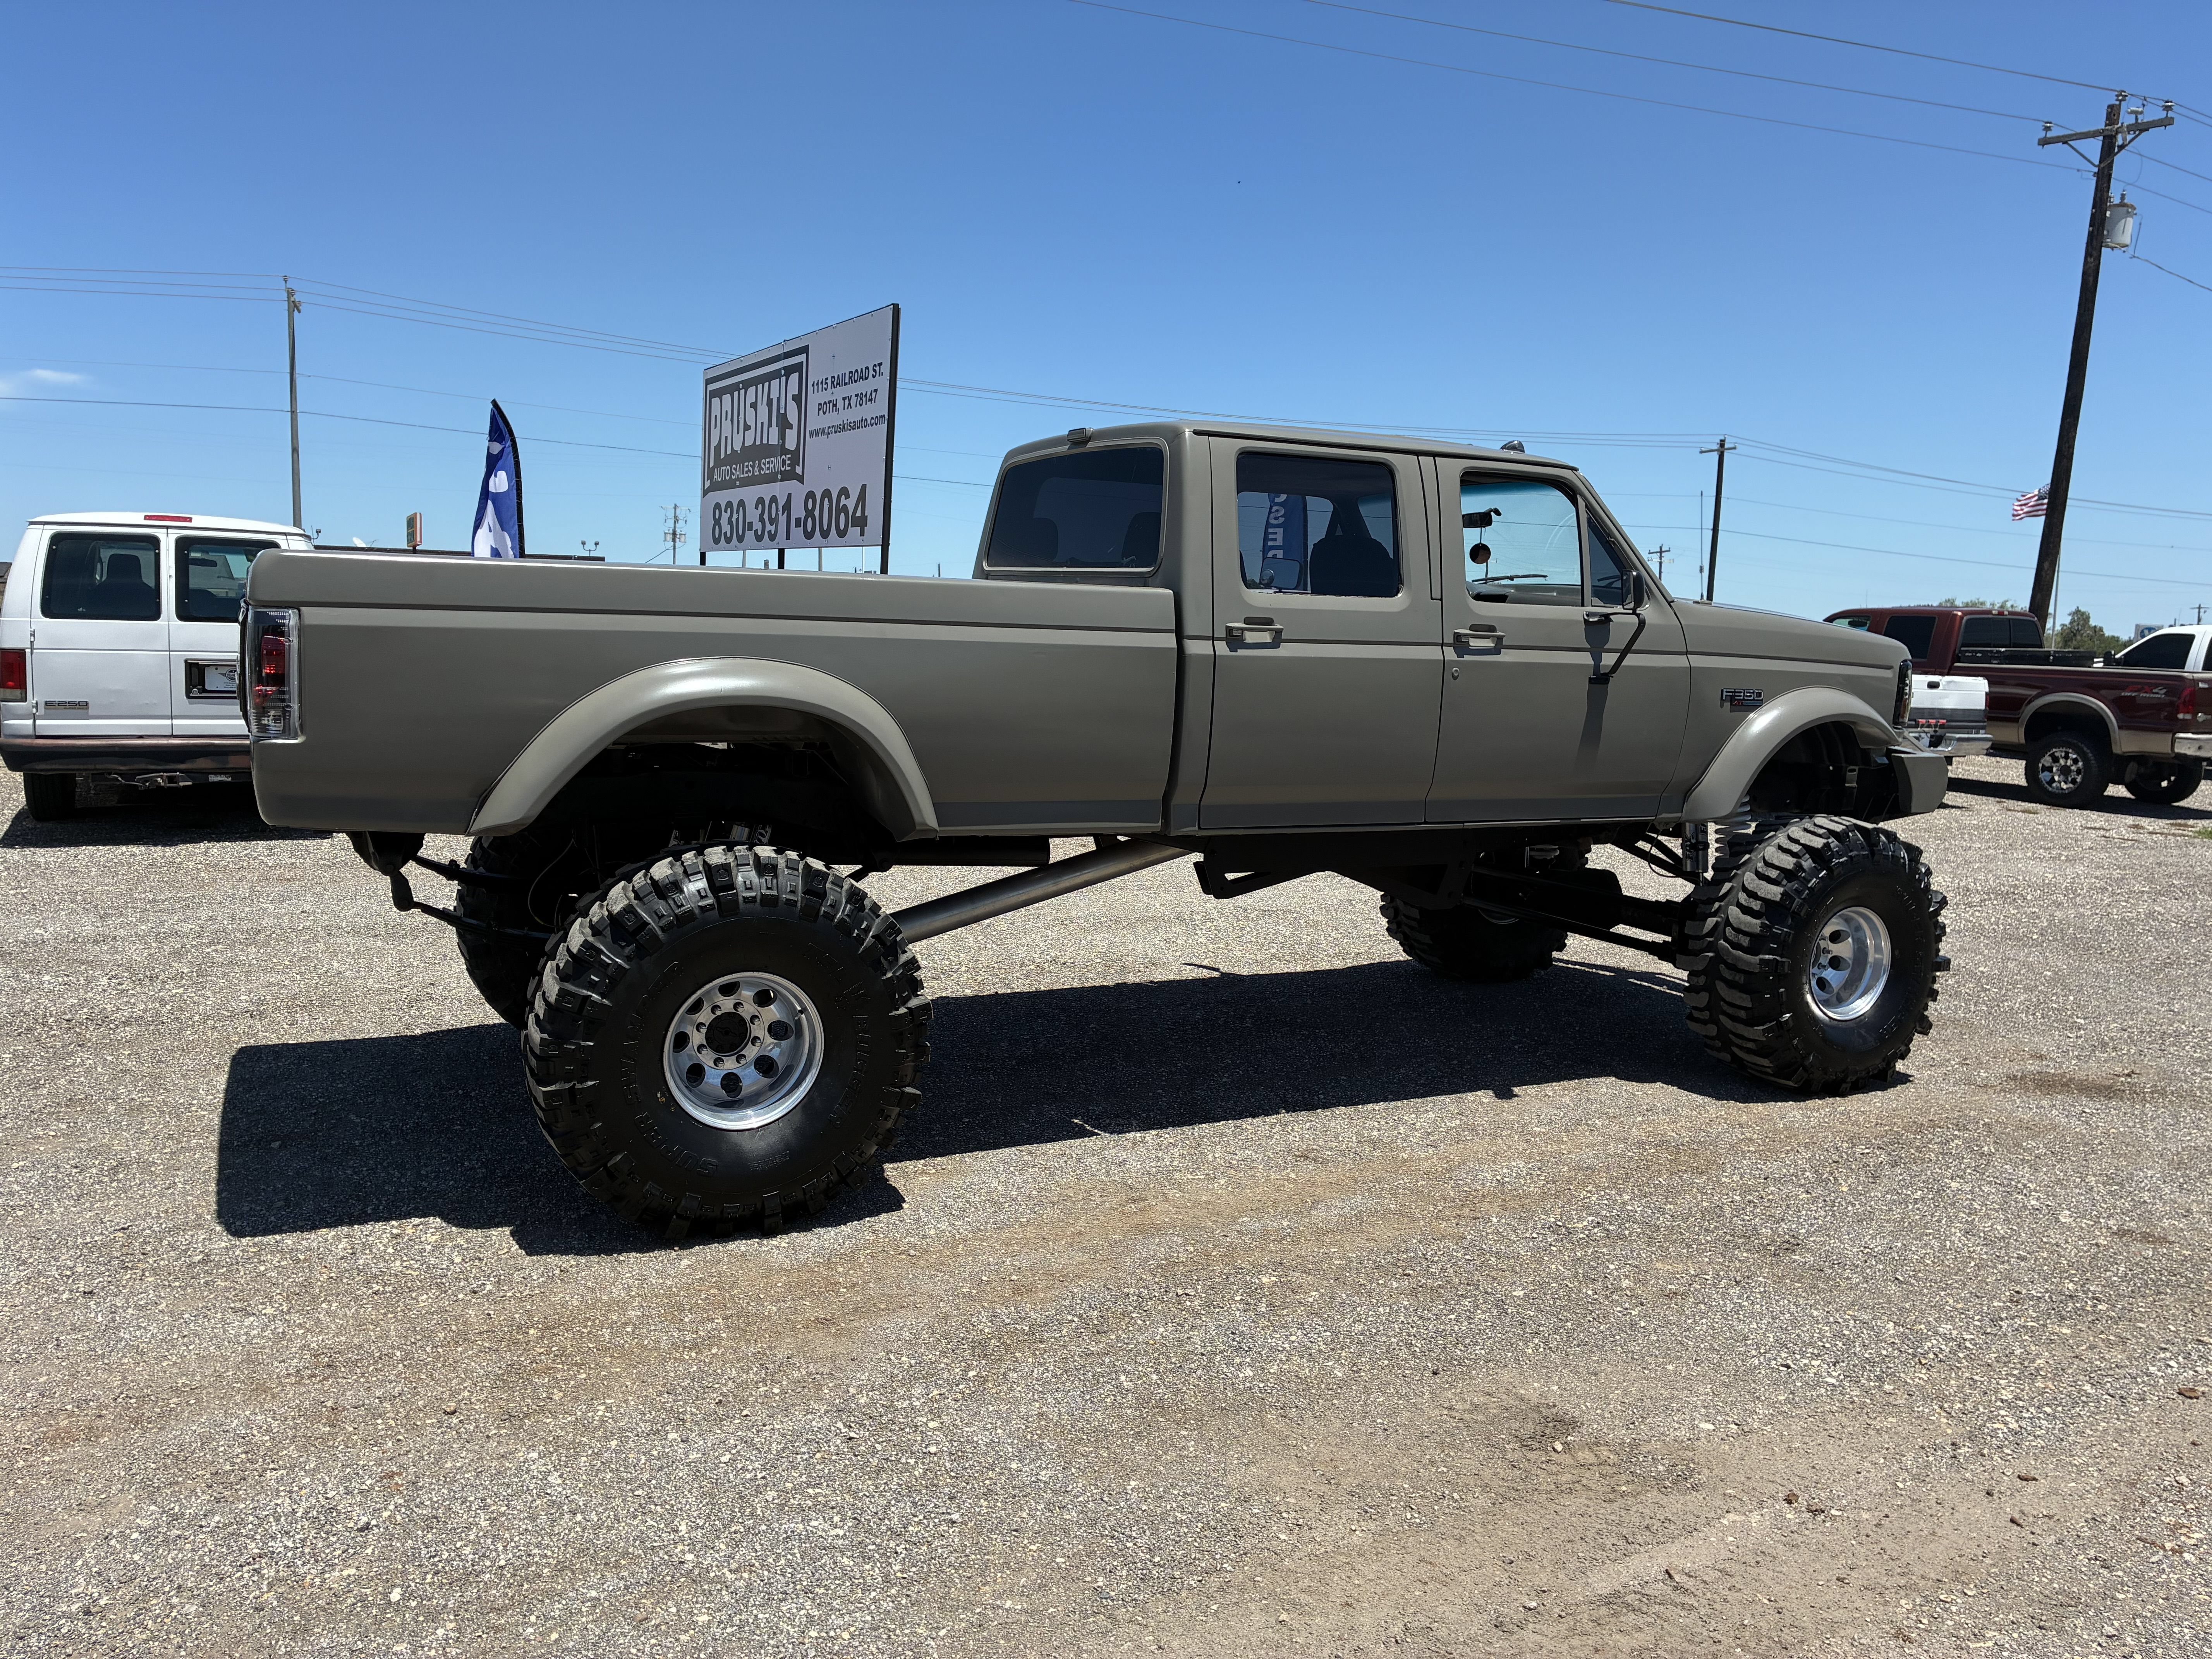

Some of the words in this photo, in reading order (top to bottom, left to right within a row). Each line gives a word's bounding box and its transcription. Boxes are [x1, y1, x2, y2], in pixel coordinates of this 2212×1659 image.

[812, 377, 828, 394] 1115
[830, 366, 870, 390] RAILROAD
[872, 362, 883, 379] ST.
[817, 398, 840, 416] POTH,
[842, 395, 852, 410] TX
[854, 388, 878, 408] 78147
[710, 372, 799, 468] PRUSKI'S
[809, 414, 885, 439] www.pruskisauto.com
[713, 465, 730, 482] AUTO
[732, 461, 753, 479] SALES
[755, 460, 759, 476] &
[761, 454, 791, 474] SERVICE
[712, 484, 868, 545] 830-391-8064
[634, 1111, 718, 1178] SUPER
